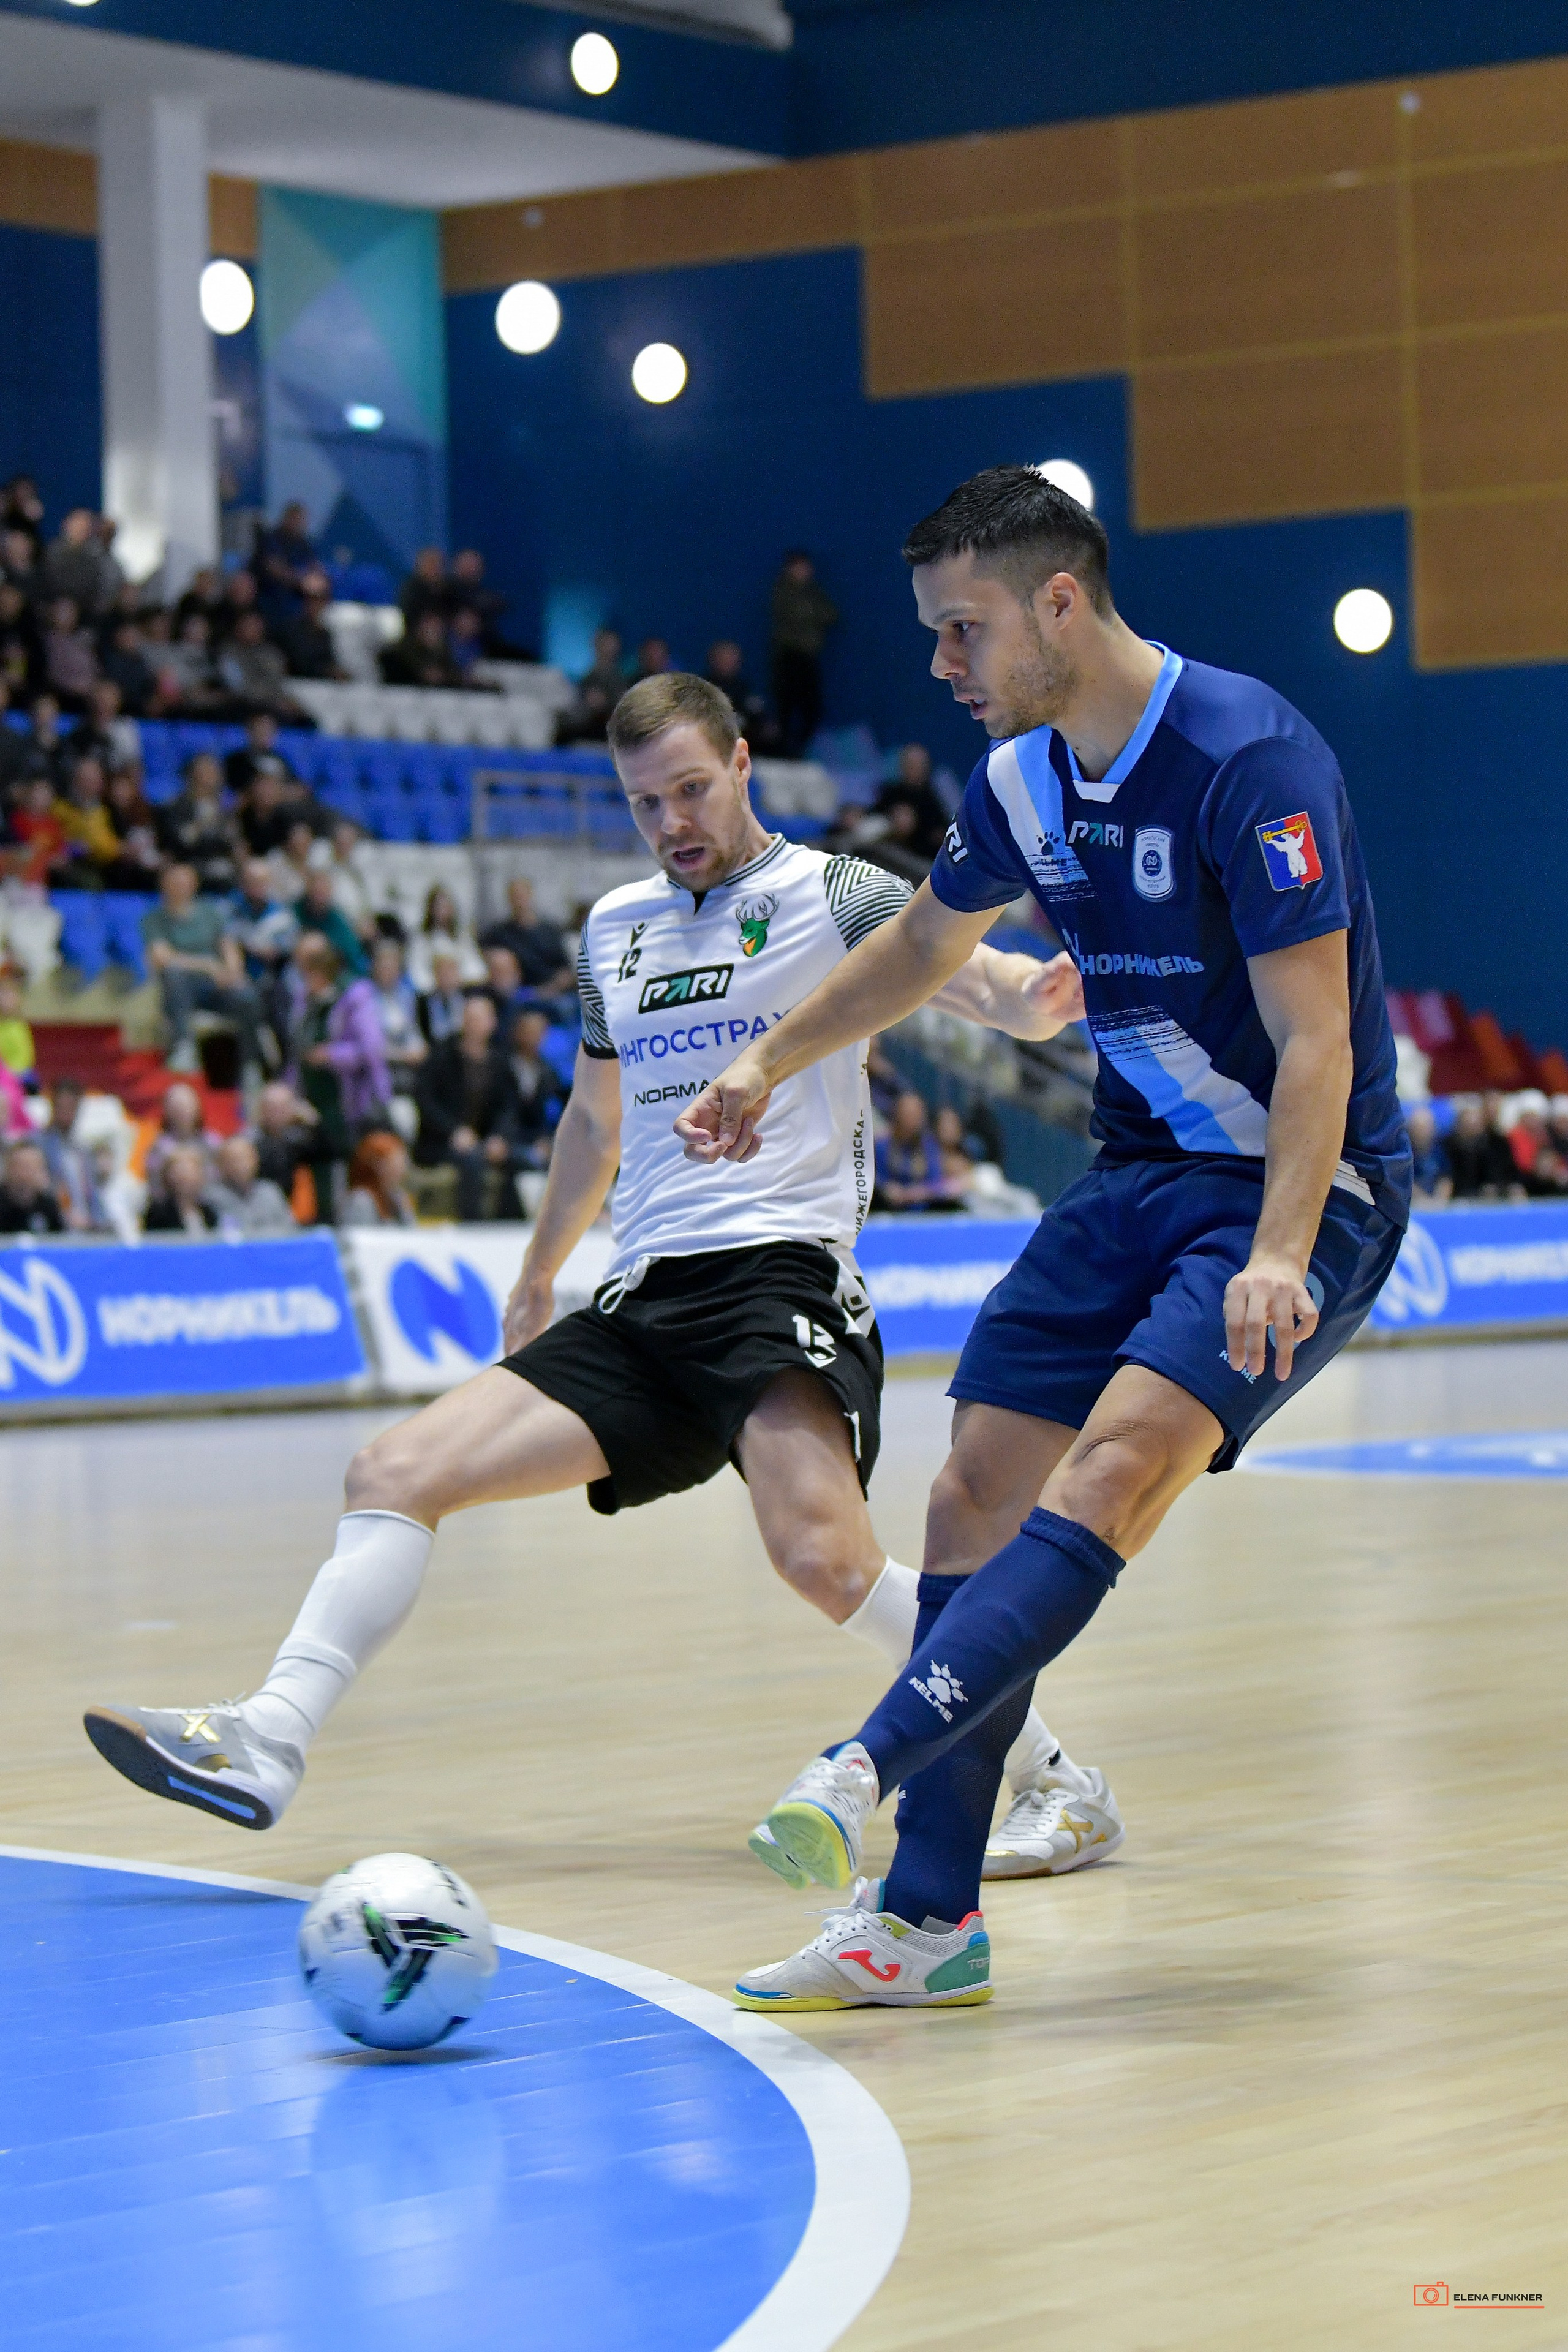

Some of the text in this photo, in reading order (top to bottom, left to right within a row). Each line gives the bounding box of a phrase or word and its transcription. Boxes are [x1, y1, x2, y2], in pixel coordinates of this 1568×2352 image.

[945, 821, 968, 862] RI
[1067, 821, 1123, 848] PARI
[1079, 954, 1205, 978] НОРНИКЕЛЬ
[641, 970, 729, 1007] PARI
[620, 1010, 788, 1068] ИНГОССТРА
[908, 1676, 954, 1724] KELME
